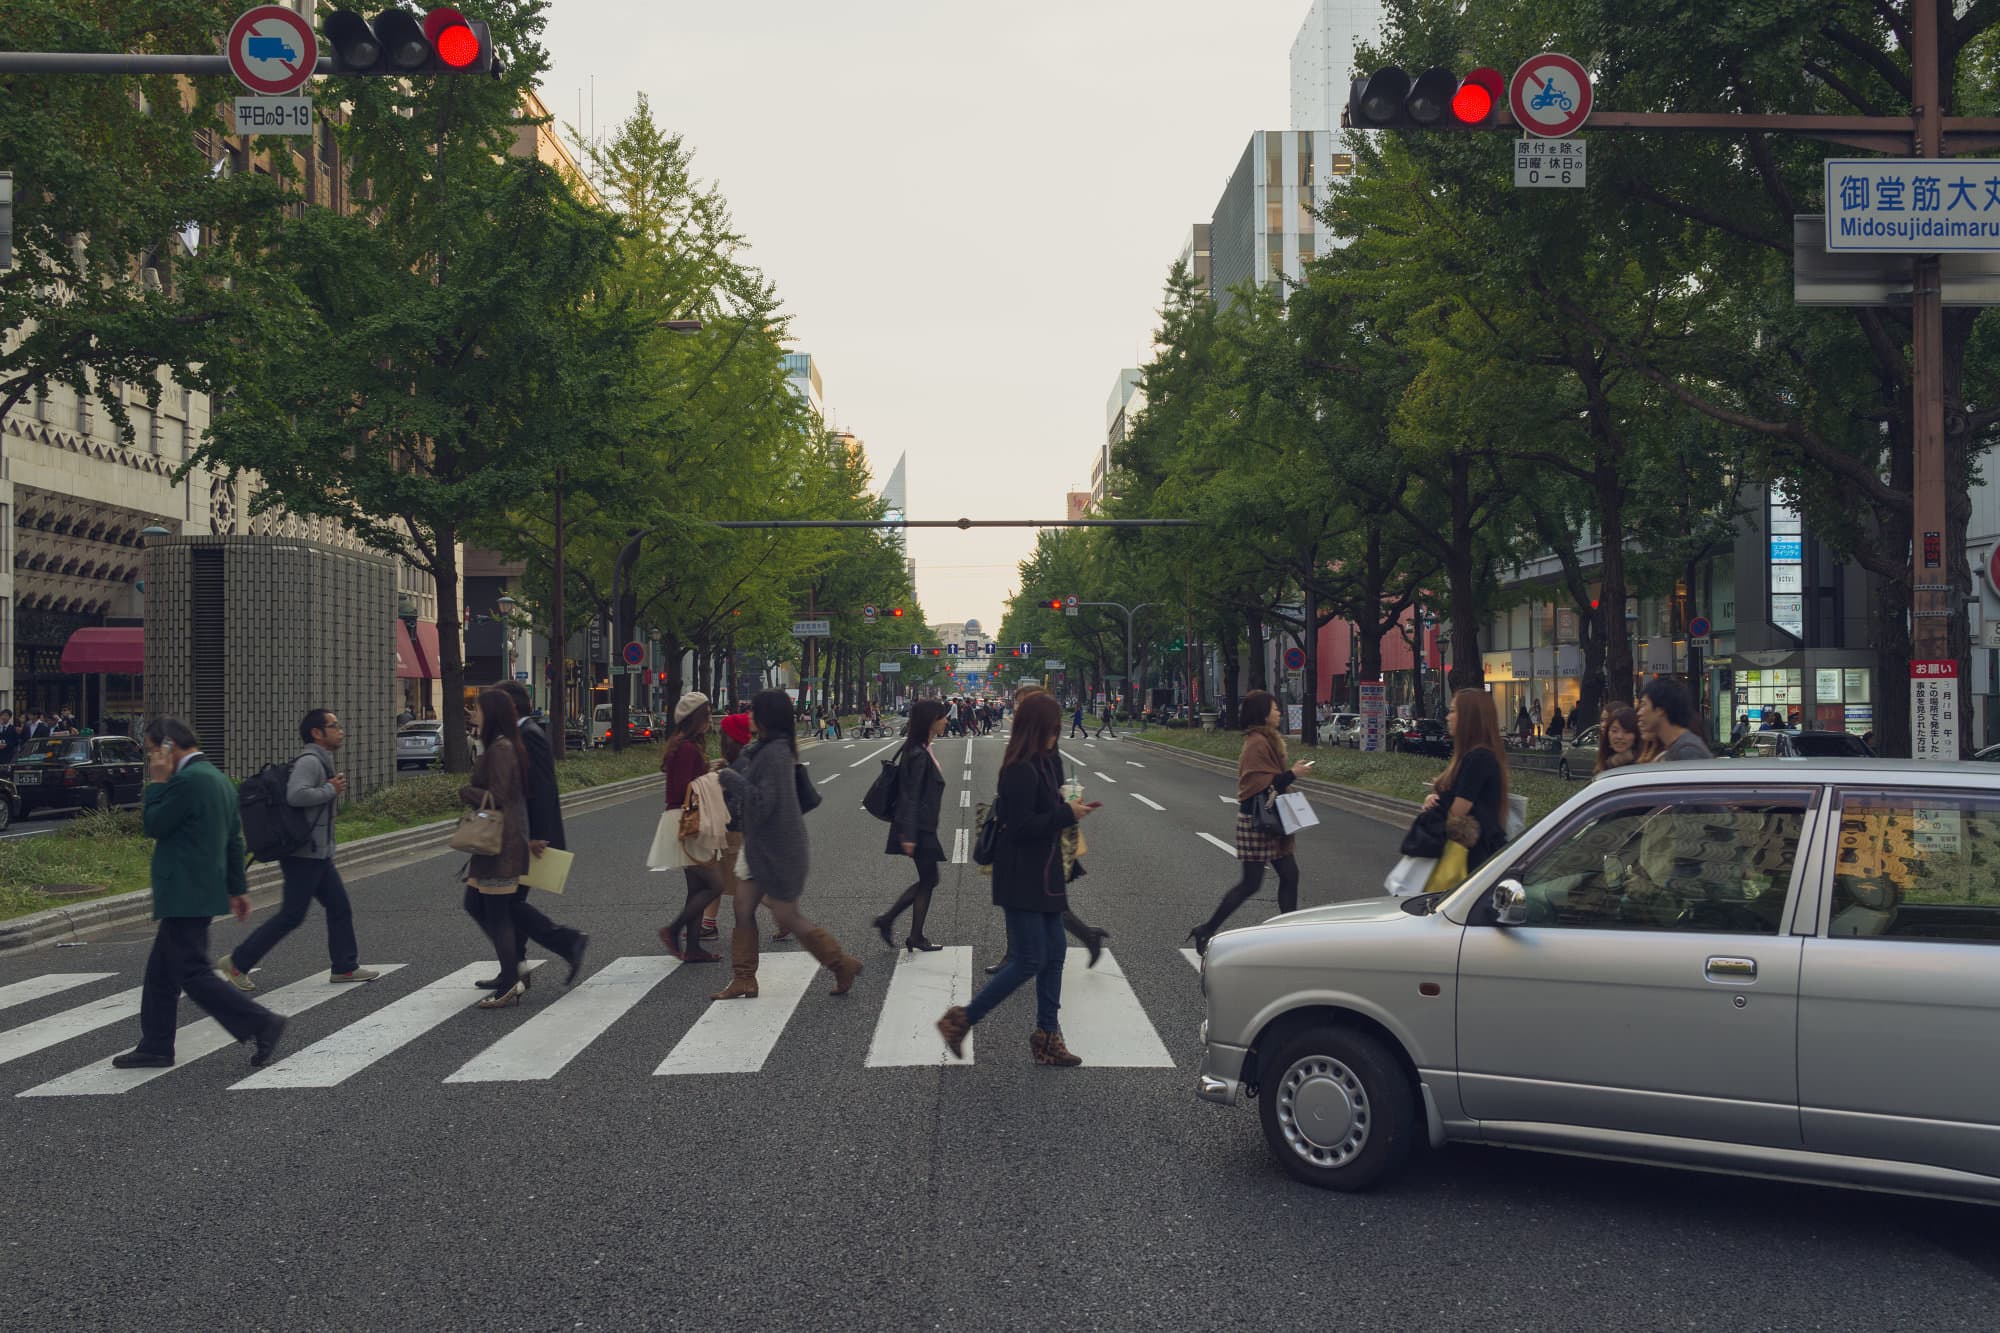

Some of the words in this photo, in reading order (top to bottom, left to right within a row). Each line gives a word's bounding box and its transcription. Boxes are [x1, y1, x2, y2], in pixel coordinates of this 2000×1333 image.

[239, 105, 309, 126] 平日の9-19
[1518, 142, 1583, 154] 原付を除く
[1840, 217, 2000, 240] Midosujidaimaru
[1915, 663, 1953, 674] お願い
